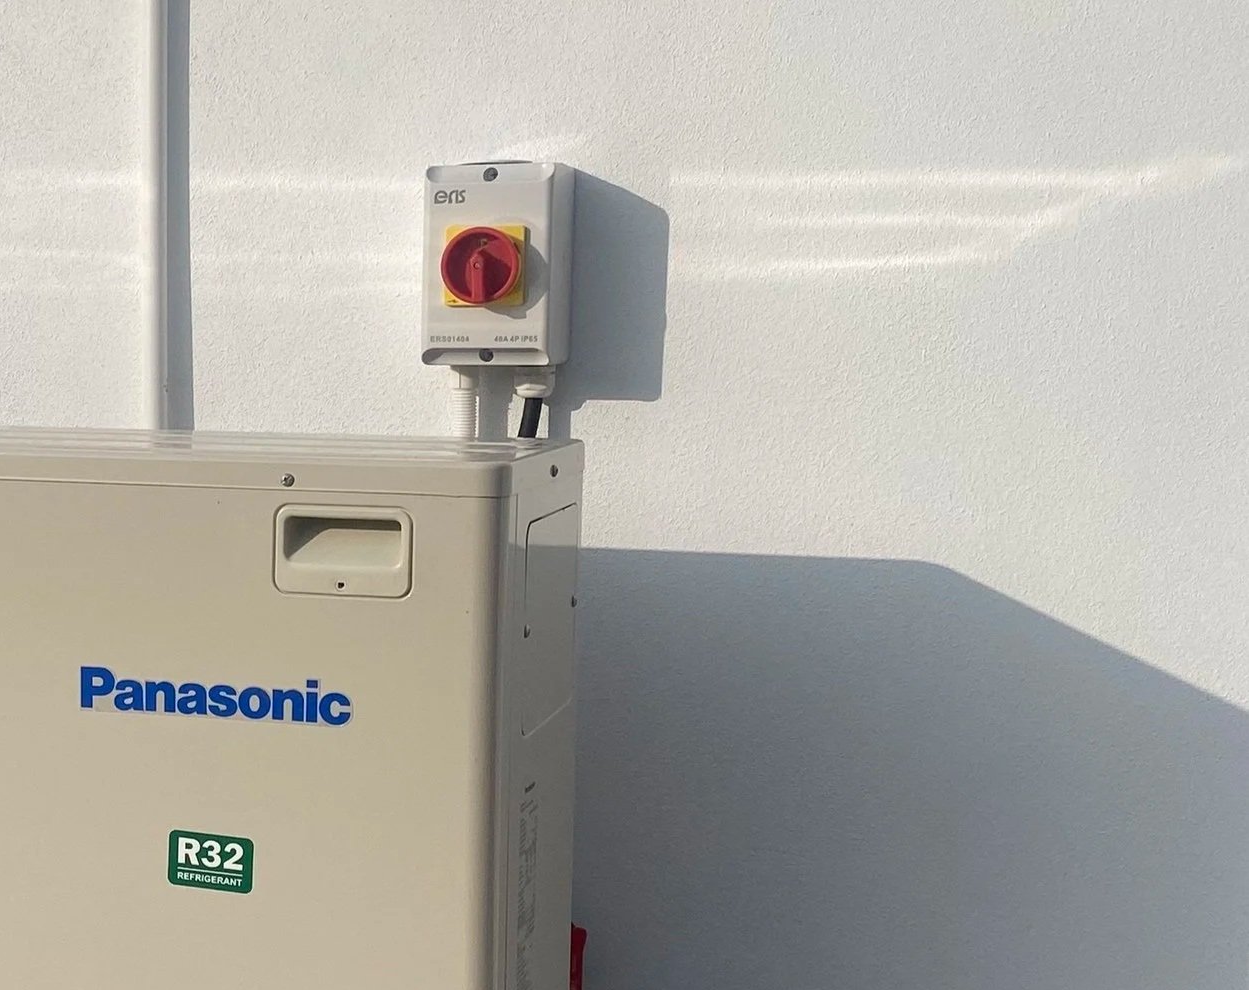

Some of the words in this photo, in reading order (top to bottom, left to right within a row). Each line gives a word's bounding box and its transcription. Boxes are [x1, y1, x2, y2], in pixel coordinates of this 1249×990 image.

[434, 189, 467, 204] eris
[520, 335, 539, 343] IP65
[80, 666, 351, 726] Panasonic
[177, 836, 244, 871] R32
[177, 871, 243, 887] REFRIGERANT
